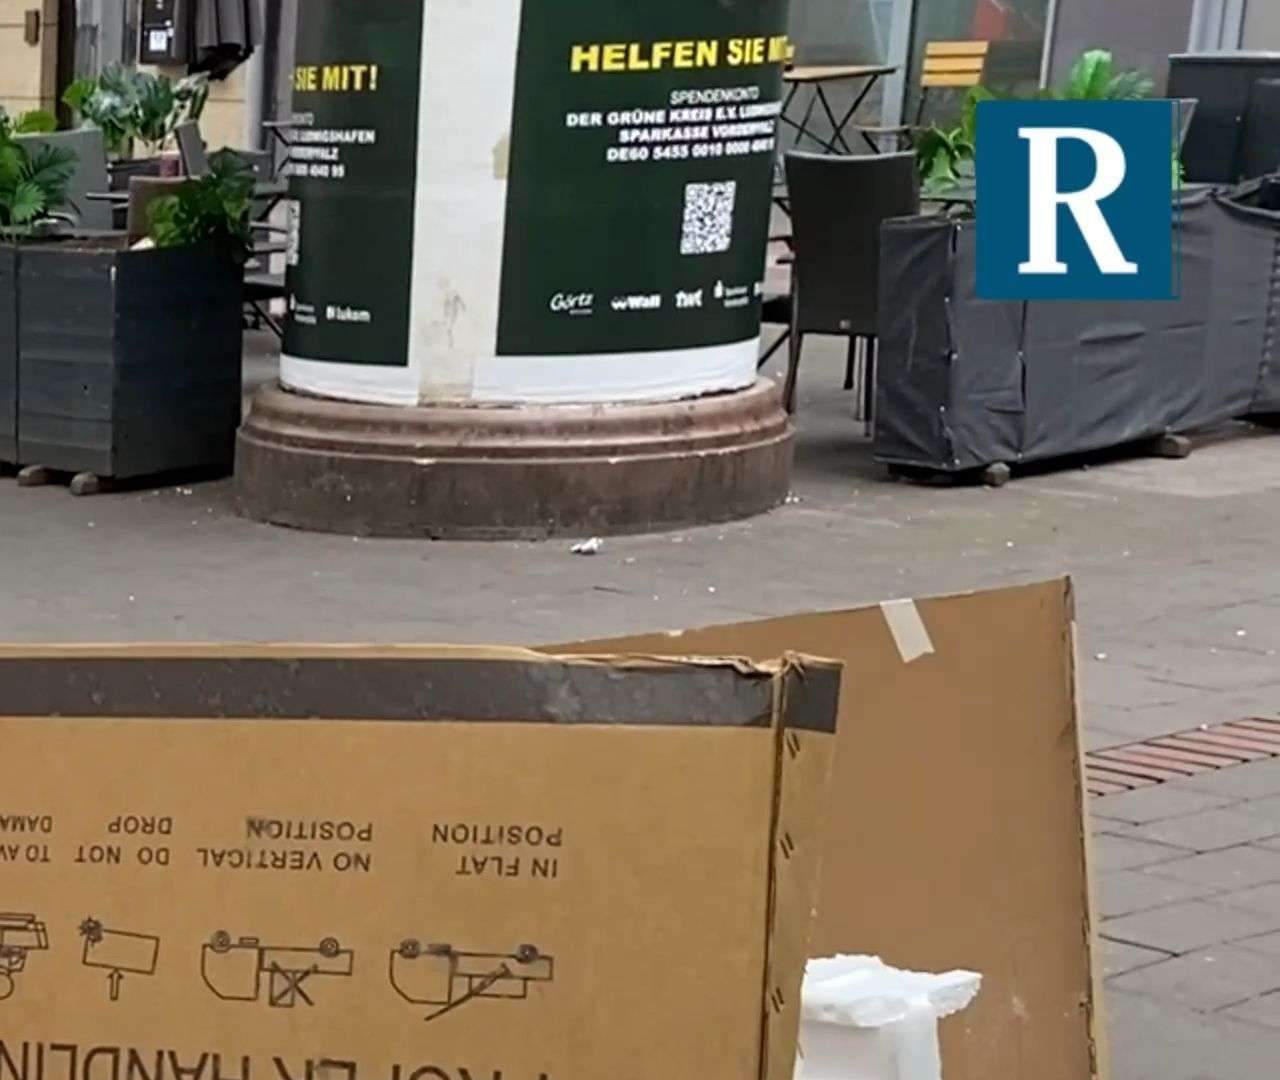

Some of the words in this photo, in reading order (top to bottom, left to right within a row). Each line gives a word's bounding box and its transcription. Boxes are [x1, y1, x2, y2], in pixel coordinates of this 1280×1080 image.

[571, 40, 719, 72] HELFEN
[727, 38, 766, 65] SIE
[296, 66, 317, 90] SIE
[322, 65, 378, 91] MIT!
[669, 86, 760, 105] SPENDENKONTO
[566, 113, 603, 127] DER
[607, 108, 666, 125] GRÜNE
[669, 107, 713, 123] KREIS
[619, 125, 709, 143] SPARKASSE
[107, 815, 173, 836] DROP
[246, 817, 373, 843] POSITION
[431, 823, 562, 848] POSITION
[25, 844, 50, 864] TO
[74, 843, 121, 866] NOT
[137, 845, 170, 866] DO
[197, 847, 323, 871] VERTICAL
[332, 850, 371, 873] NO
[455, 854, 522, 877] FLAT
[532, 857, 558, 878] IN
